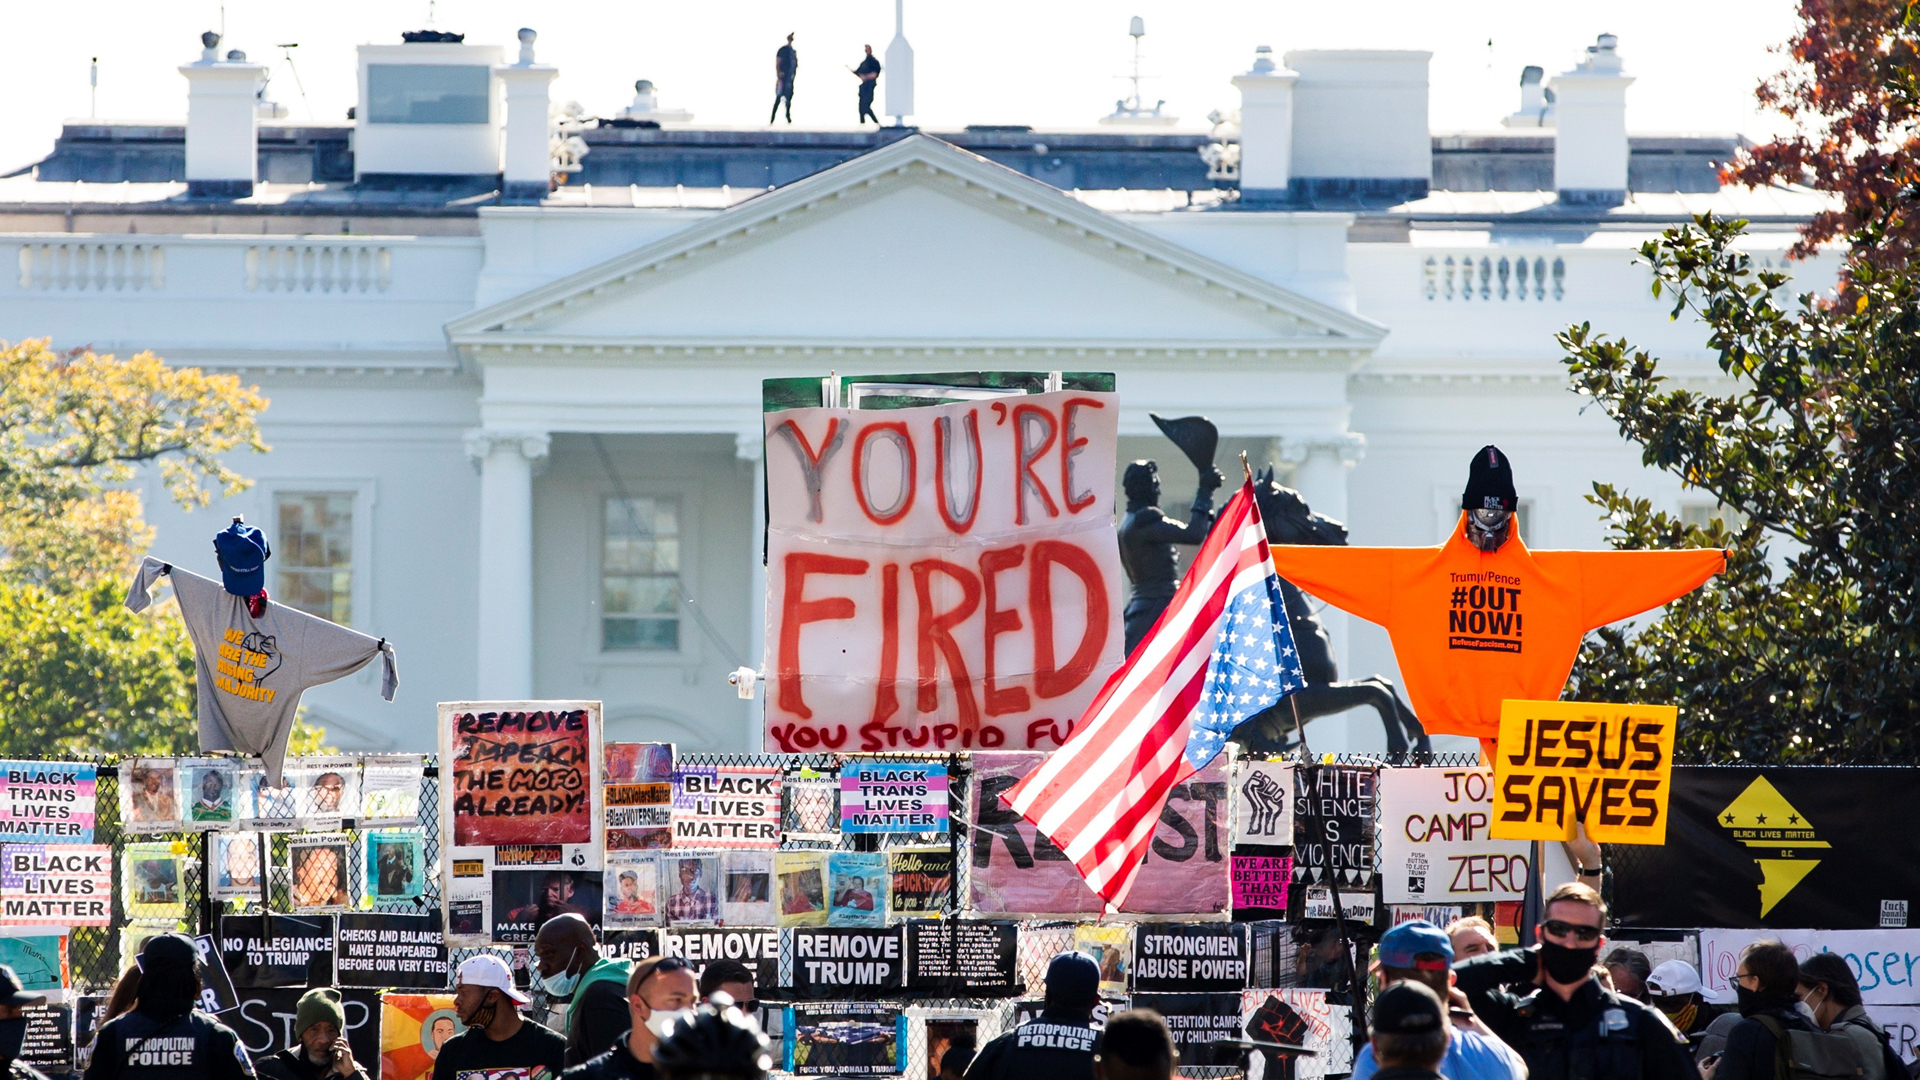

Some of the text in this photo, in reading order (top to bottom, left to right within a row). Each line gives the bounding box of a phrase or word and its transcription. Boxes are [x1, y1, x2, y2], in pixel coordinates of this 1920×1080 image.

[774, 397, 1105, 534] YOU'RE
[1450, 571, 1520, 585] Trump/Pence
[1451, 585, 1521, 611] #OUT
[1449, 610, 1522, 636] NOW!
[224, 627, 245, 645] WE
[778, 540, 1109, 732] FIRED
[1452, 639, 1518, 651] RefuseFascism.org
[218, 643, 267, 668] ARE THE
[217, 659, 254, 682] RISING
[216, 675, 276, 703] MAJORITY
[458, 710, 585, 734] REMOVE
[771, 718, 1074, 753] YOU STUPID FU
[1508, 717, 1664, 770] JESUS
[9, 771, 77, 785] BLACK
[453, 768, 582, 792] THE MOFO
[860, 771, 927, 782] BLACK
[1298, 769, 1372, 798] WHITE
[685, 777, 773, 794] BLACK
[859, 785, 927, 796] TRANS
[8, 788, 76, 801] TRANS
[1501, 775, 1661, 831] SAVES
[12, 805, 70, 818] LIVES
[454, 791, 584, 816] ALREADY!
[697, 801, 764, 816] LIVES
[865, 800, 922, 810] LIVES
[0, 821, 81, 835] MATTER
[854, 815, 935, 825] MATTER
[1405, 813, 1491, 841] CAMP
[677, 822, 775, 838] MATTER
[1734, 830, 1756, 838] BLACK
[1785, 831, 1815, 839] MATTER
[14, 855, 102, 872] BLACK
[893, 854, 923, 872] Hello
[924, 860, 951, 871] and
[1235, 858, 1289, 869] WE ARE
[1294, 844, 1372, 868] VIOENCE
[1233, 870, 1291, 882] BETTER
[1448, 854, 1529, 892] ZERO
[25, 879, 94, 894] LIVES
[1240, 883, 1282, 894] THAN
[6, 900, 104, 916] MATTER
[1243, 894, 1279, 906] THIS
[1884, 901, 1904, 910] fuck
[1318, 905, 1339, 918] BLA
[497, 923, 535, 931] MAKE
[223, 937, 333, 951] NO ALLEGIANCE
[340, 929, 444, 944] CHECKS AND BALANCE
[349, 944, 437, 958] HAVE DISAPPEARED
[620, 941, 649, 958] LIES
[666, 933, 778, 959] REMOVE
[798, 935, 899, 959] REMOVE
[1144, 935, 1238, 957] STRONGMEN
[247, 952, 310, 965] TO TRUMP
[338, 958, 447, 974] BEFORE OUR VERY EYES
[805, 961, 890, 985] TRUMP
[1137, 958, 1245, 980] ABUSE POWER
[1243, 989, 1331, 1016] BLACK LIVES
[241, 999, 370, 1052] STP
[1162, 1016, 1242, 1028] DETENTION CAMPS
[1299, 1011, 1331, 1040] MATTER
[1018, 1023, 1097, 1041] METROPOLITAN
[1018, 1035, 1092, 1051] POLICE
[128, 1052, 192, 1066] POLICE
